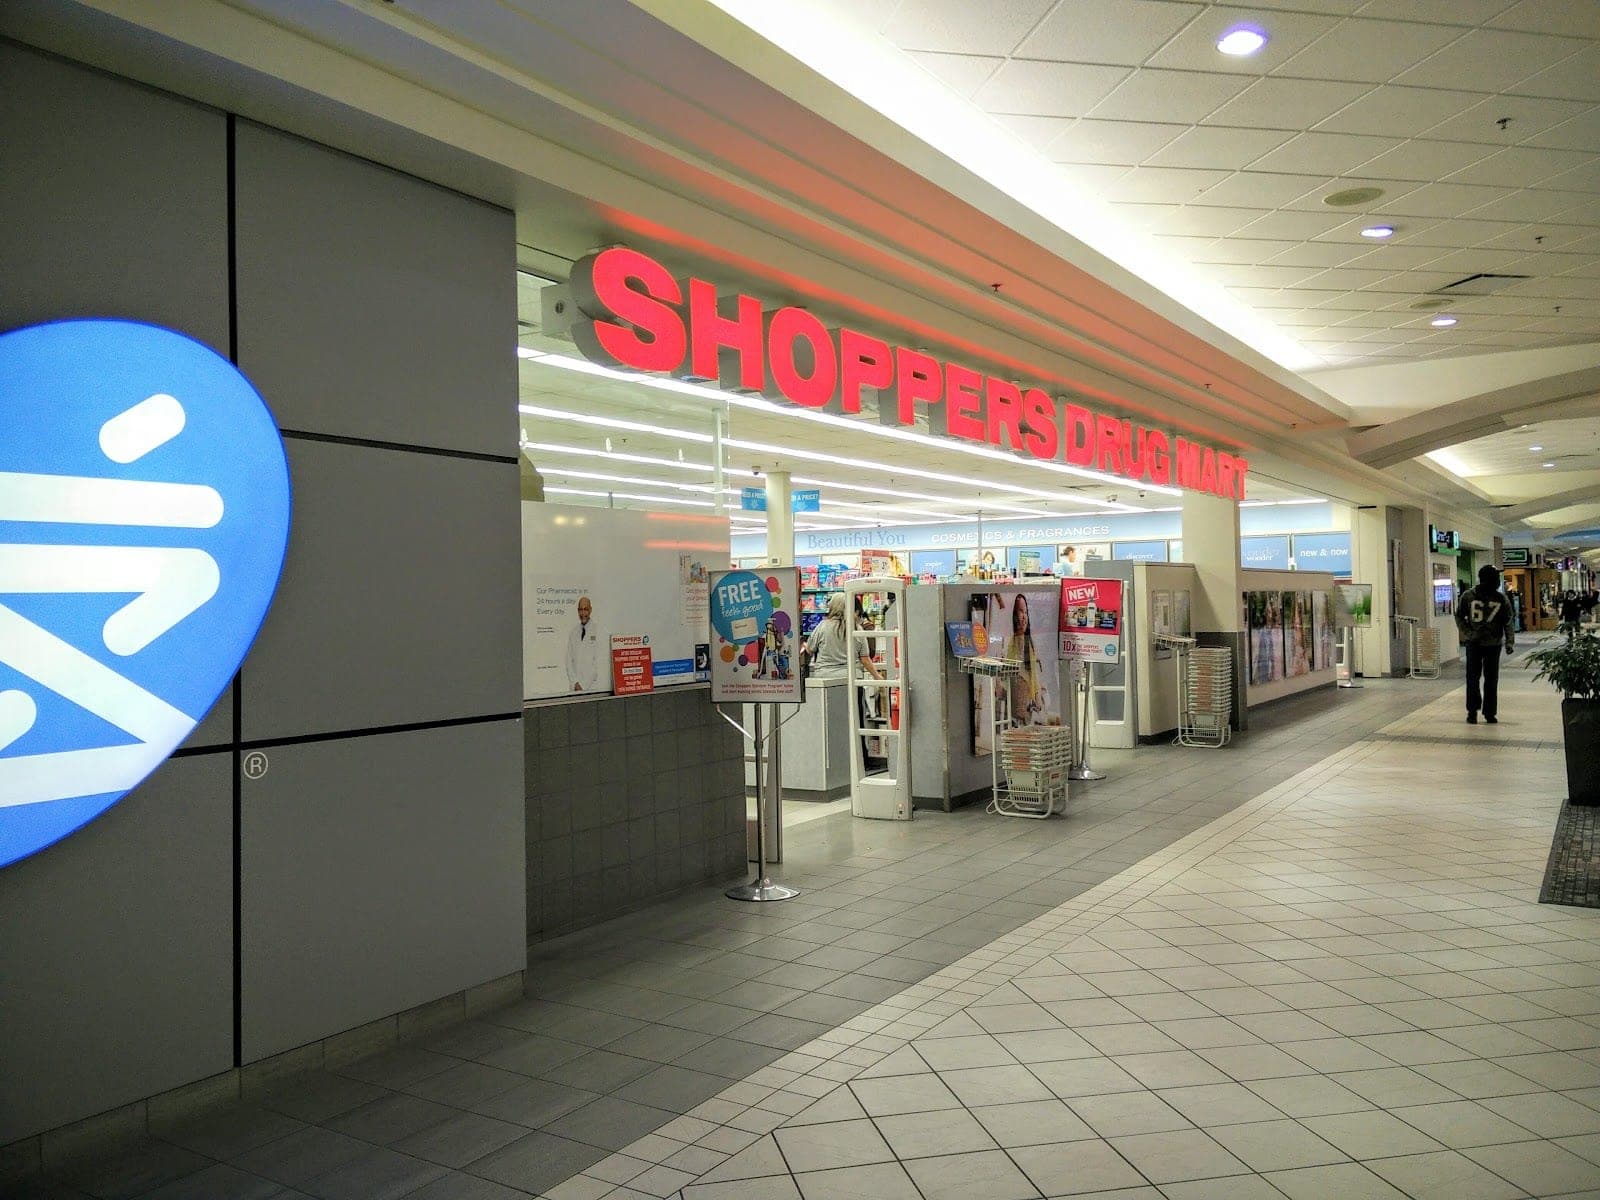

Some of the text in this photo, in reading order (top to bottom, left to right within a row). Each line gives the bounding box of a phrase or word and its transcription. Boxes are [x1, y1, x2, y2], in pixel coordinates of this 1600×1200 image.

[592, 247, 1248, 500] SHOPPERS DRUG MART
[807, 530, 906, 549] Beautiful You
[1006, 530, 1015, 540] &
[1020, 525, 1111, 540] FRAGRANCES
[1300, 547, 1348, 558] new & now
[717, 579, 762, 607] FREE
[1068, 585, 1096, 601] NEW
[536, 608, 553, 616] Every
[721, 606, 740, 618] feels
[742, 601, 764, 617] good
[1470, 600, 1502, 623] 67
[1063, 640, 1076, 651] 10x
